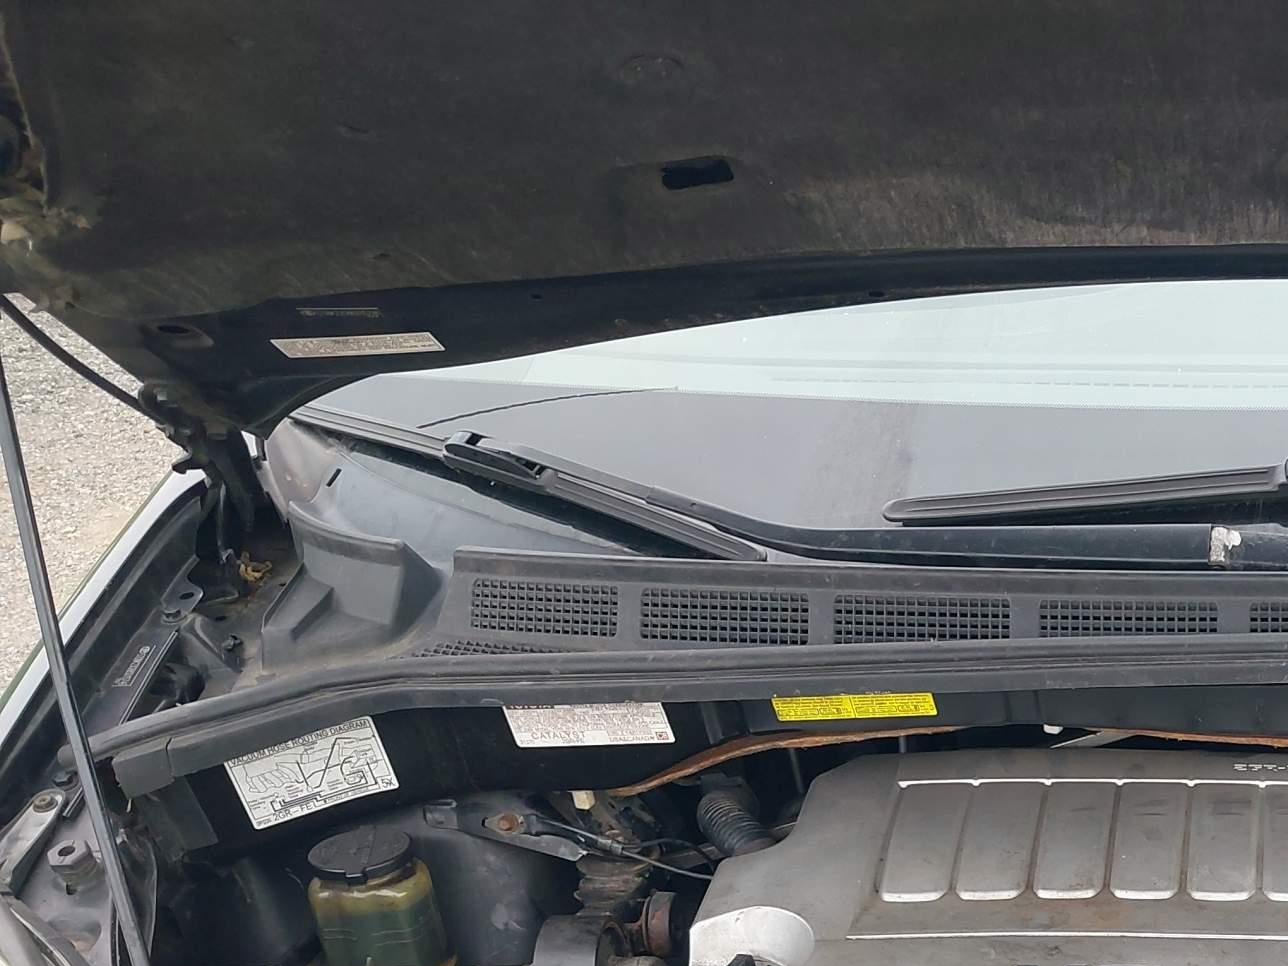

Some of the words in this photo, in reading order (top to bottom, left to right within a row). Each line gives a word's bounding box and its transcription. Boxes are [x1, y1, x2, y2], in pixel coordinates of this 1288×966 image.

[231, 748, 268, 766] VACUUM
[268, 742, 295, 756] HOSE
[295, 730, 330, 747] ROUTING
[329, 720, 368, 735] DIAGRAM
[530, 731, 586, 741] CATALYST
